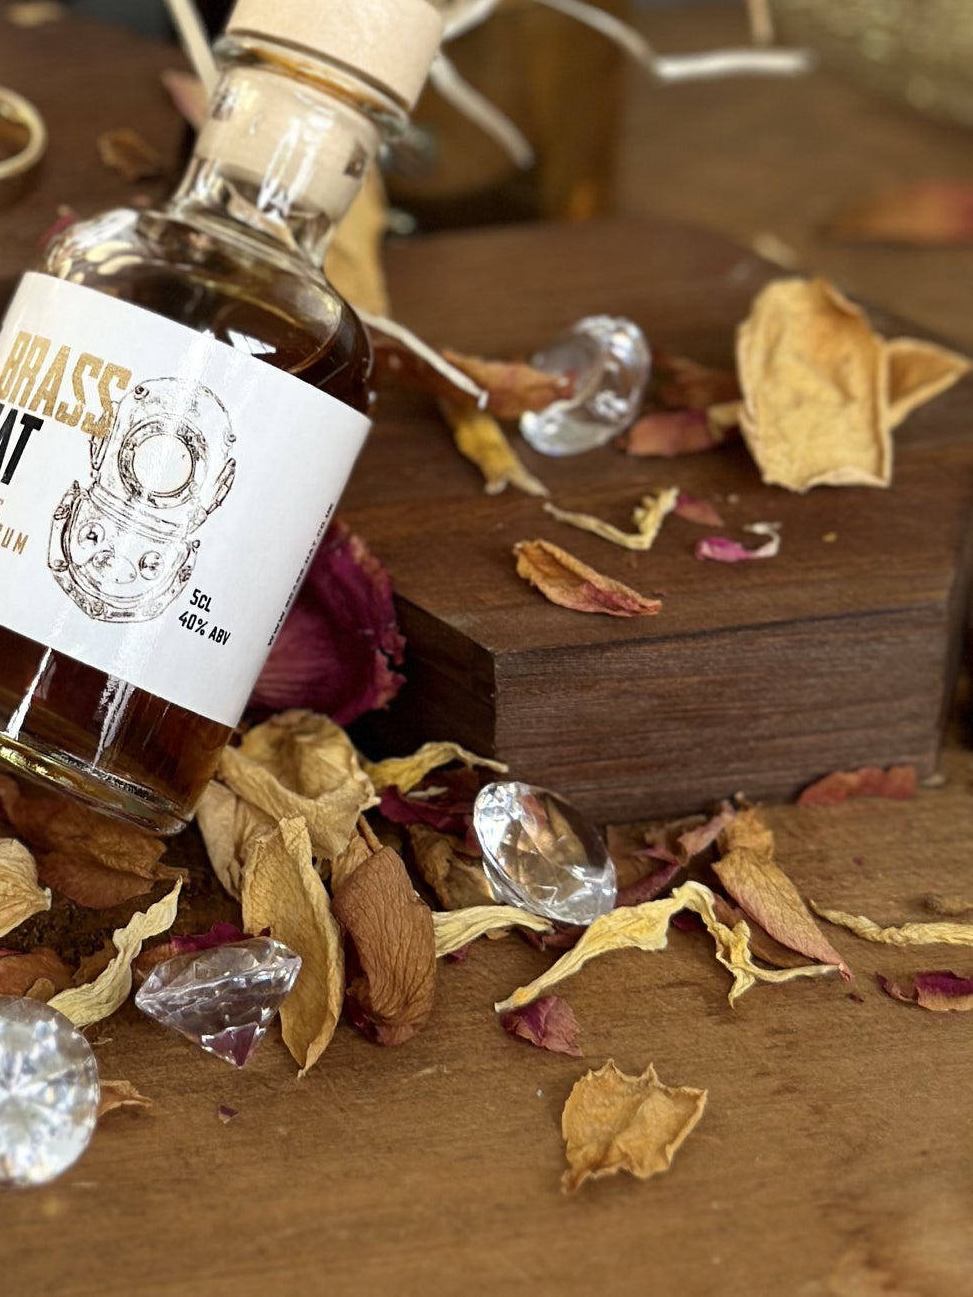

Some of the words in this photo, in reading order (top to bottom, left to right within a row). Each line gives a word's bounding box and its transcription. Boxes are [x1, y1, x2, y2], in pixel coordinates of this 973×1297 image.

[189, 588, 212, 613] 5CL
[178, 610, 209, 636] 40%
[208, 625, 231, 645] ABV
